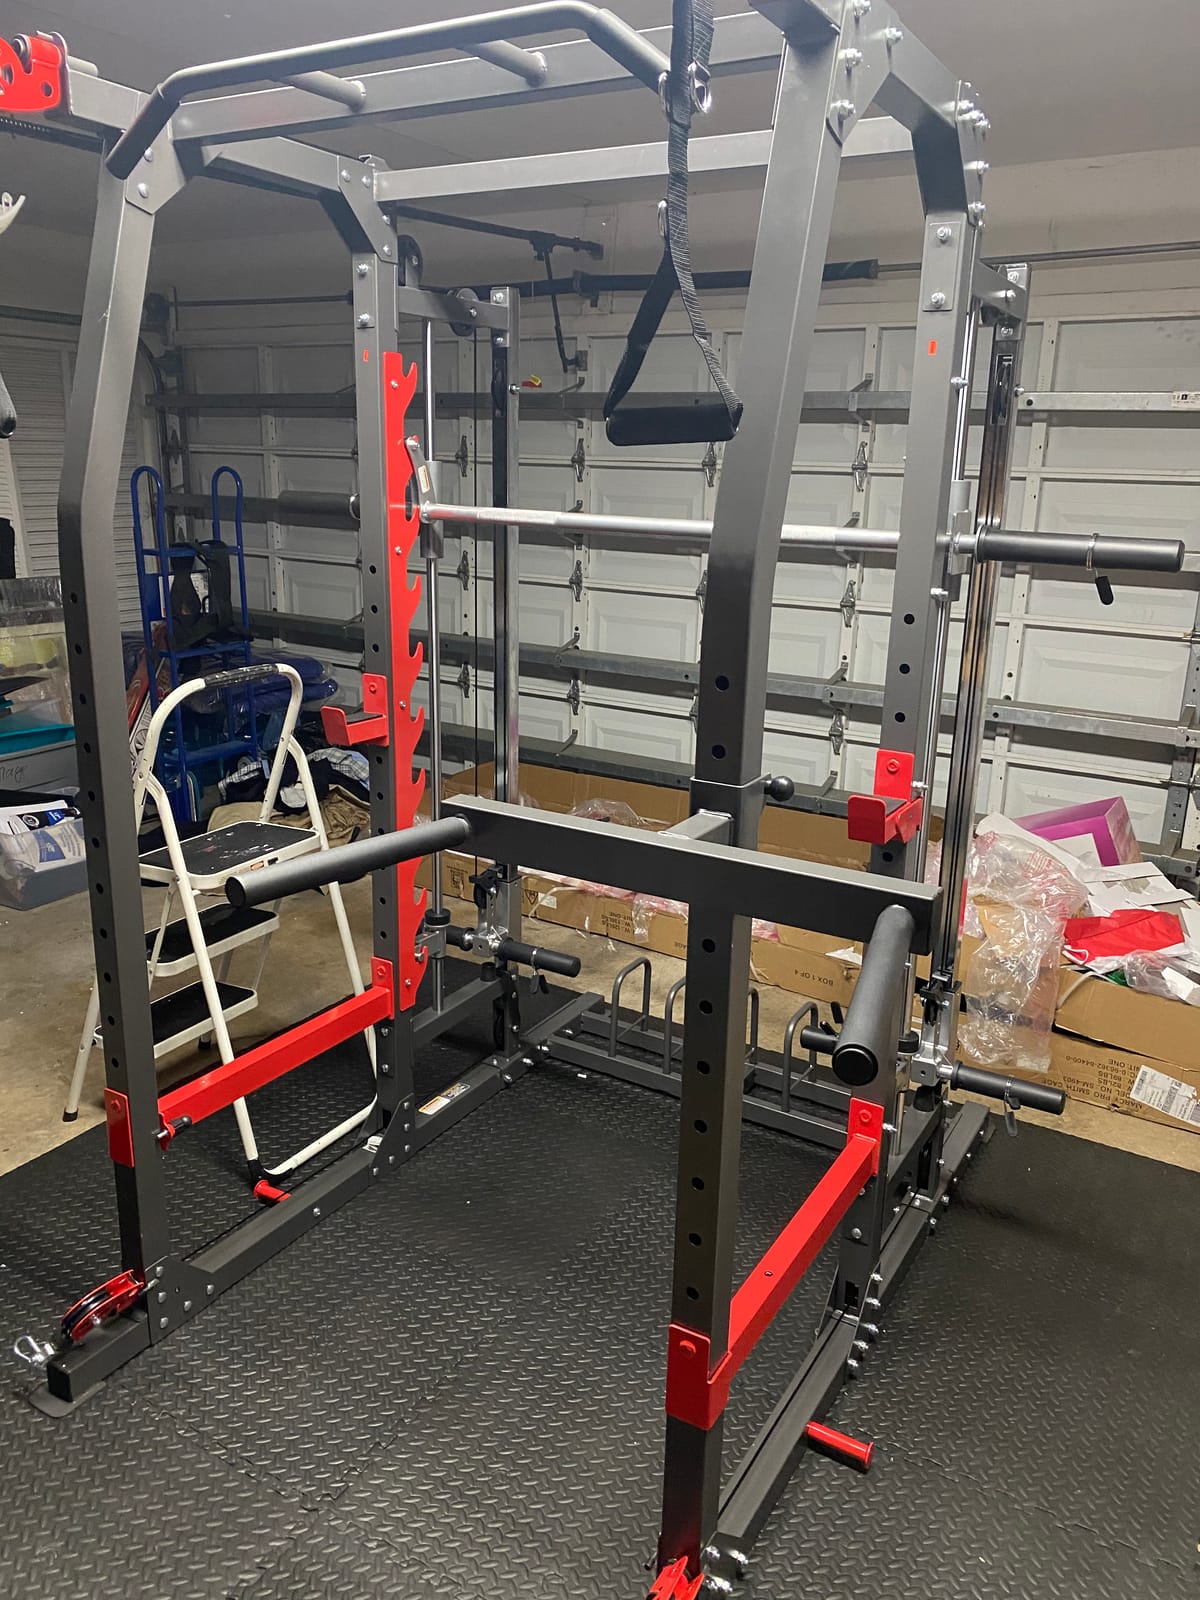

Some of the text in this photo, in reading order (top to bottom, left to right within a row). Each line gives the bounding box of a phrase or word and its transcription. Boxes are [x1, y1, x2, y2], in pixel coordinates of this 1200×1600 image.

[800, 971, 811, 979] OF
[817, 976, 834, 986] BOX
[1108, 1058, 1126, 1068] ONE
[1042, 1078, 1143, 1109] MARCY PRO SMITH CAGE
